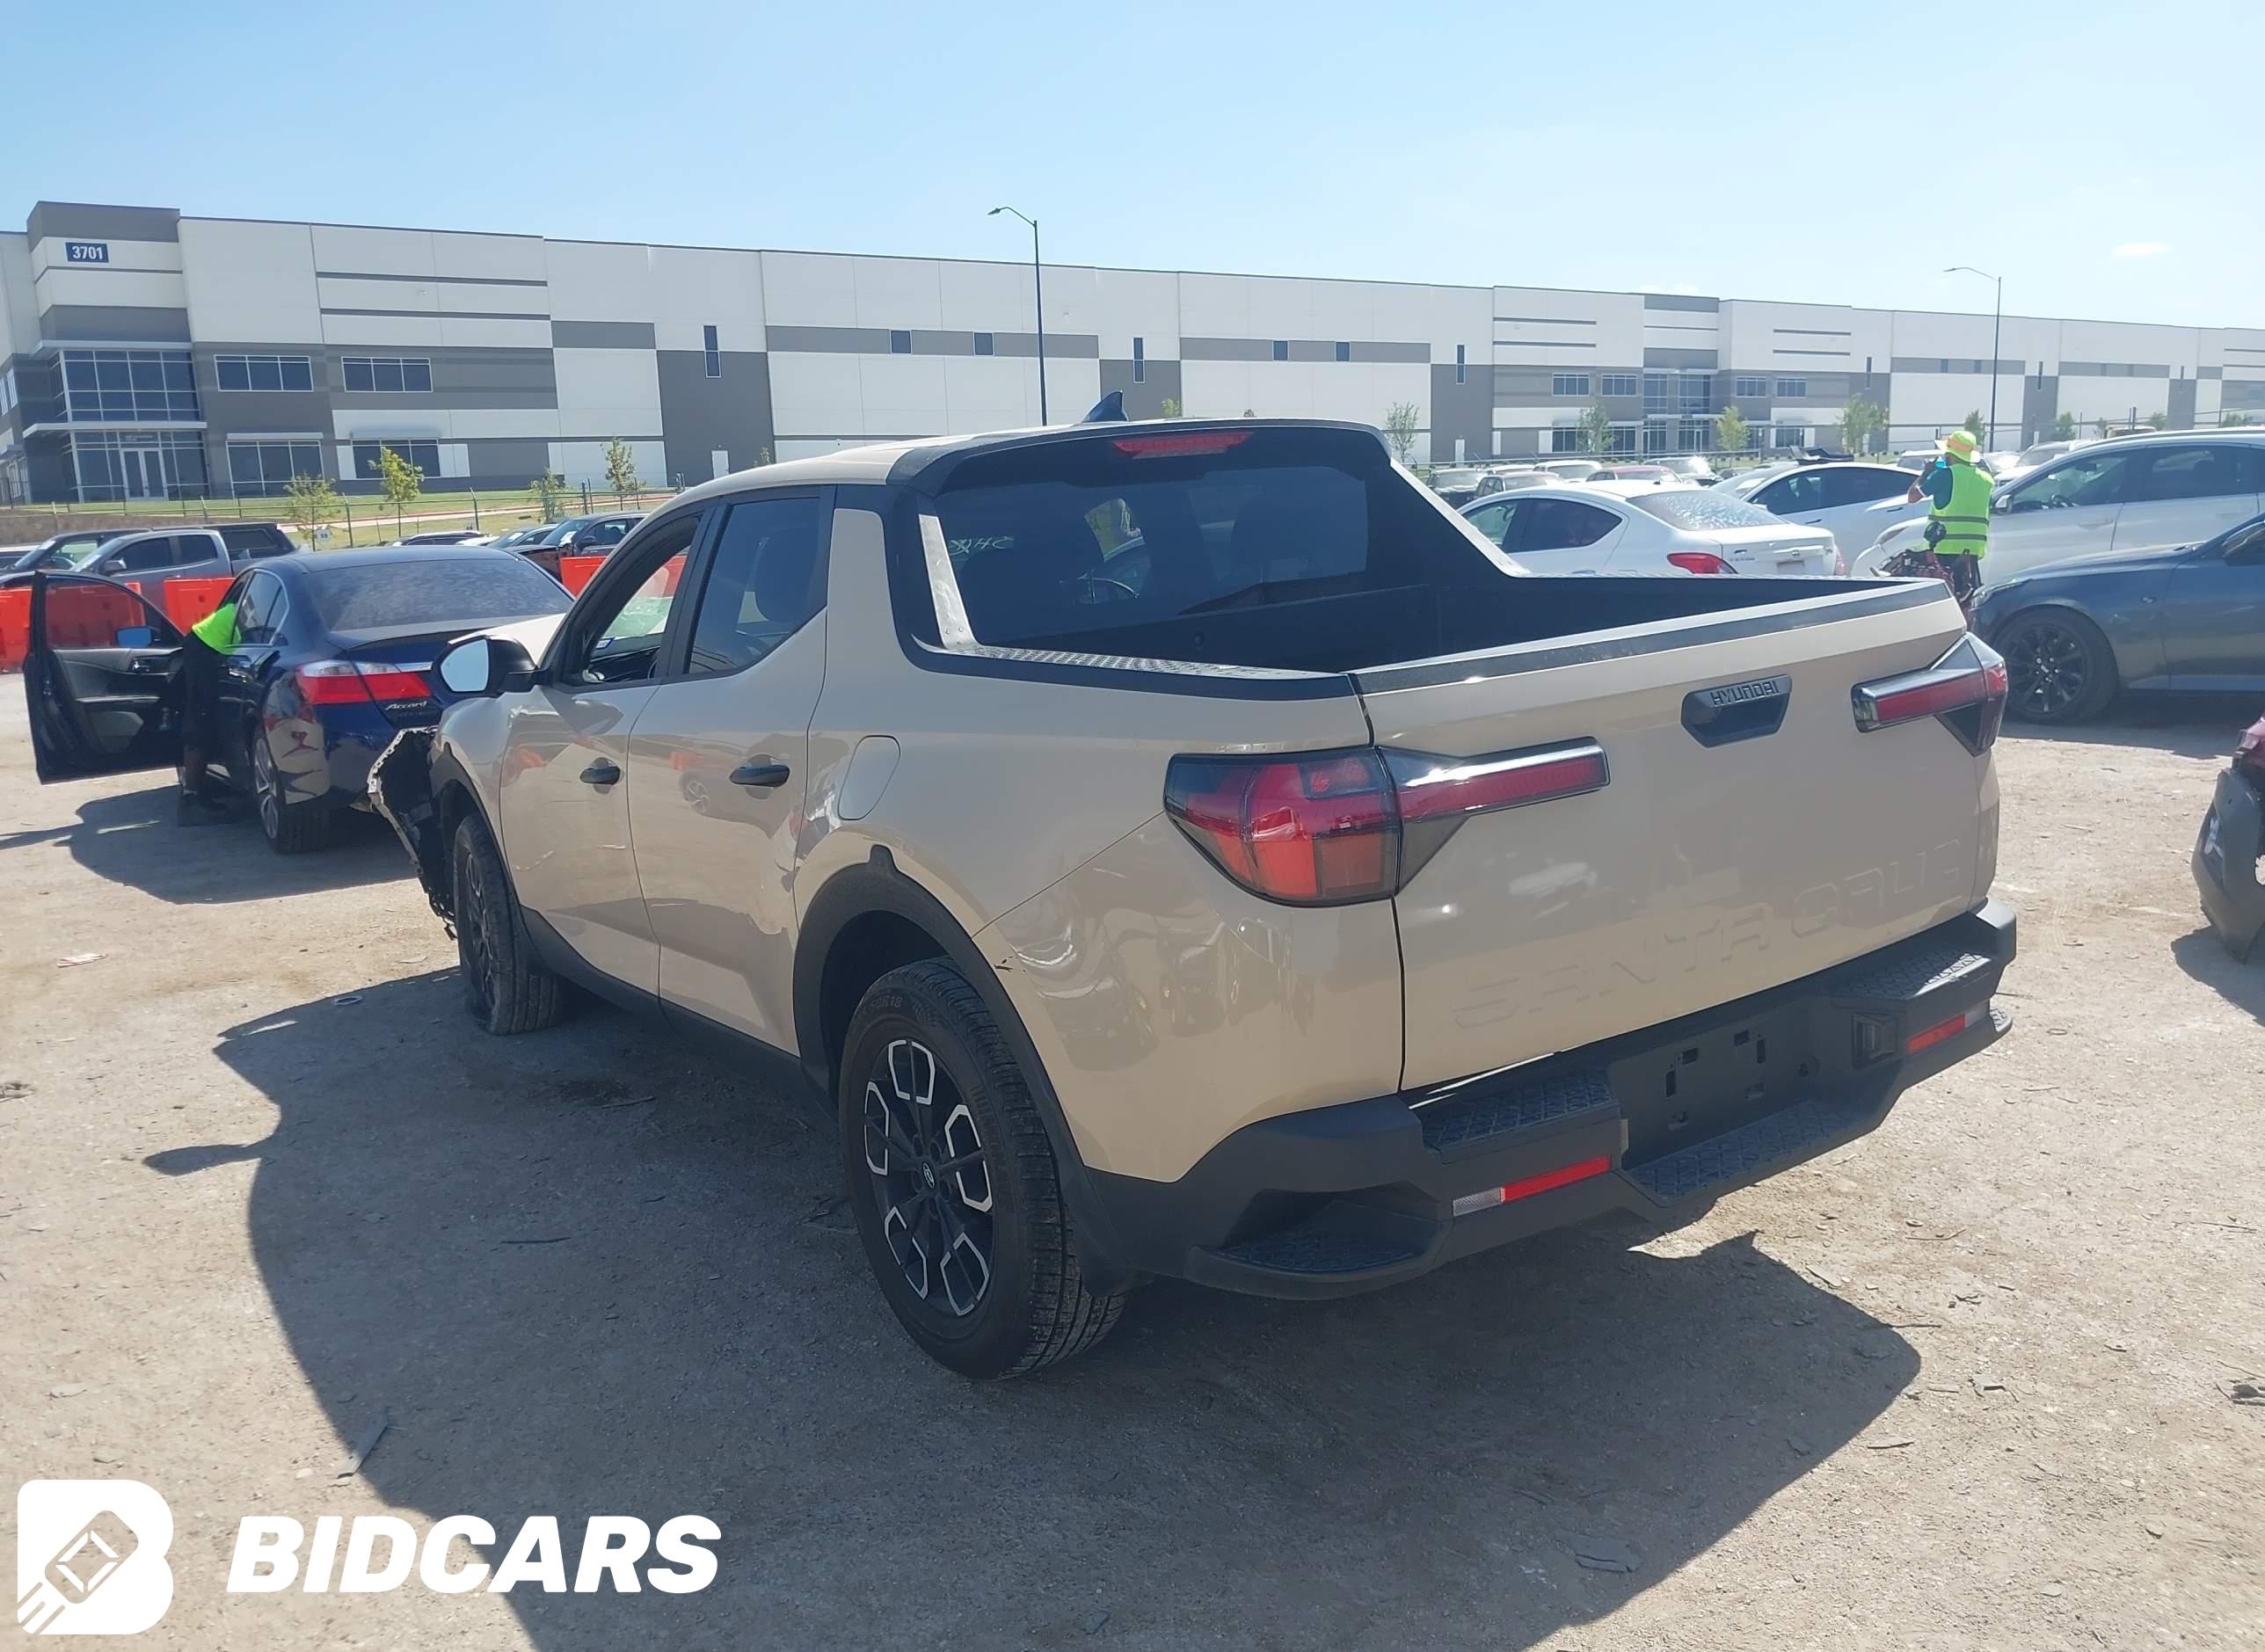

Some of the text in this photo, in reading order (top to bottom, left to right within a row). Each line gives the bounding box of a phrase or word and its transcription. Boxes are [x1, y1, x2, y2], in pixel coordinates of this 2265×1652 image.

[71, 245, 103, 260] 3701
[1709, 680, 1781, 706] HYUNDAI
[1452, 902, 1774, 1030] SANTA
